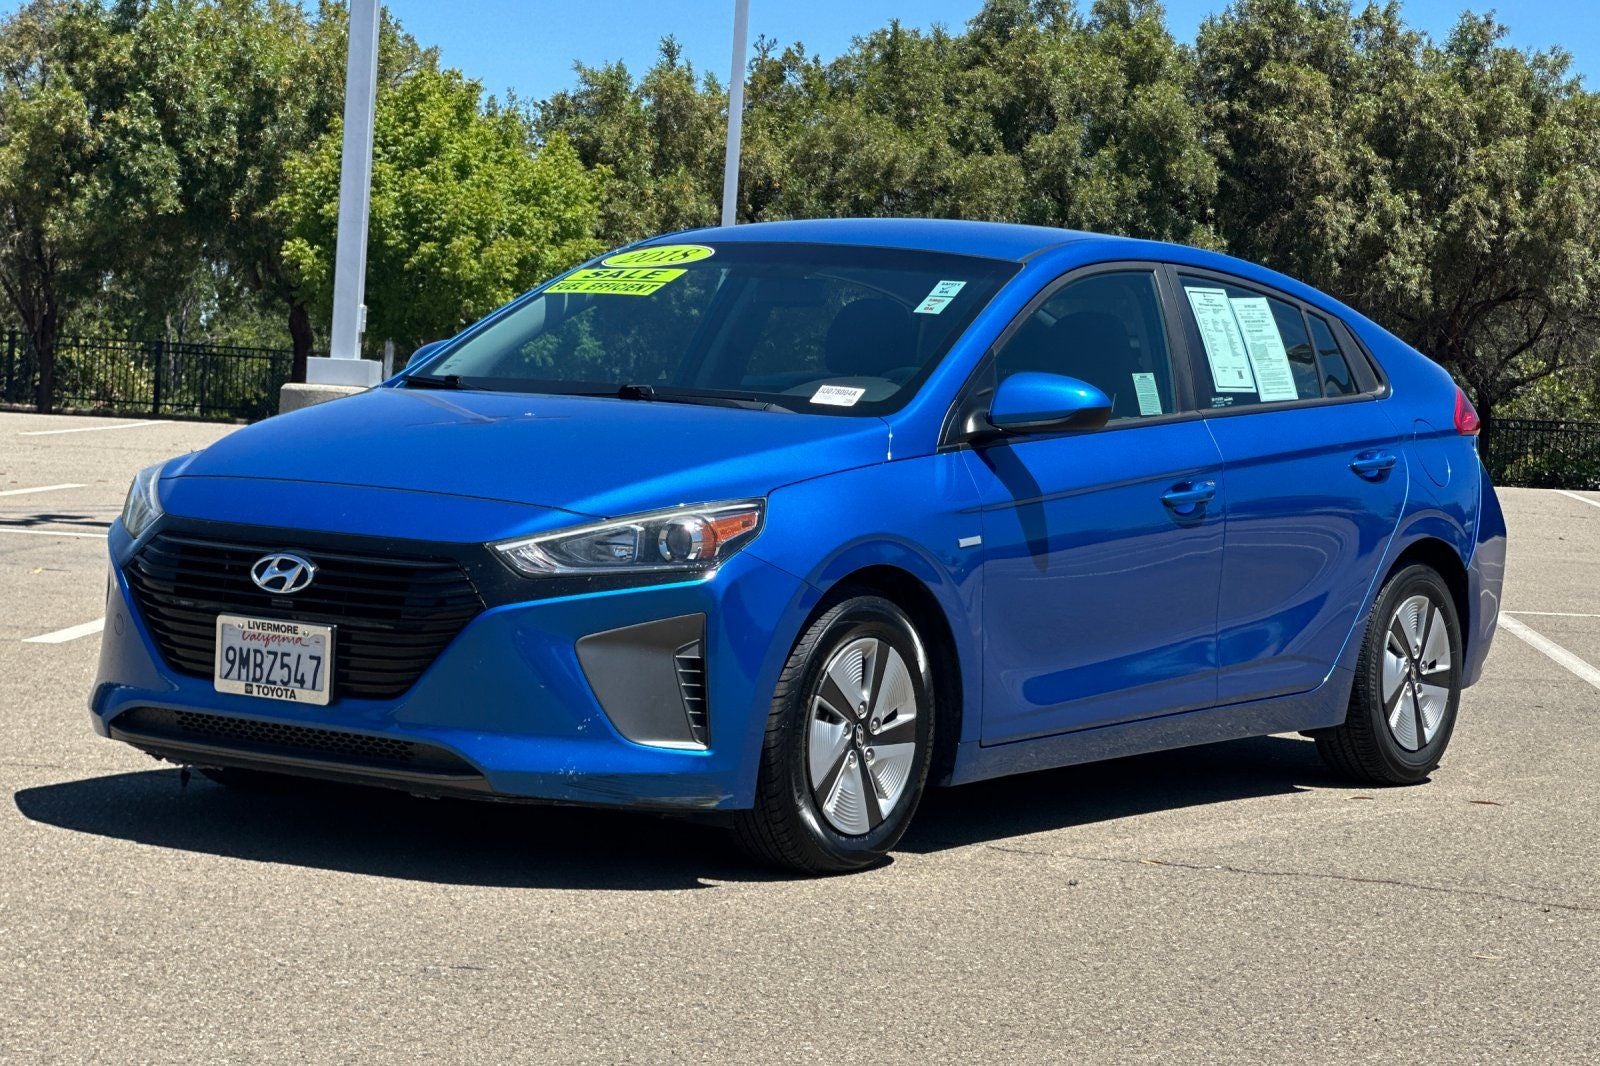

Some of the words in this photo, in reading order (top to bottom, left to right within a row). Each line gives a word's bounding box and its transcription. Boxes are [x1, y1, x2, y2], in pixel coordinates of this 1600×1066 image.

[614, 248, 701, 265] 2018
[582, 269, 670, 280] SALE
[555, 283, 583, 292] FUEL
[586, 283, 660, 293] EFFICIENT
[247, 619, 299, 635] LIVERMORE
[224, 646, 321, 690] 9MBZ547
[255, 684, 297, 700] TOYOTA
